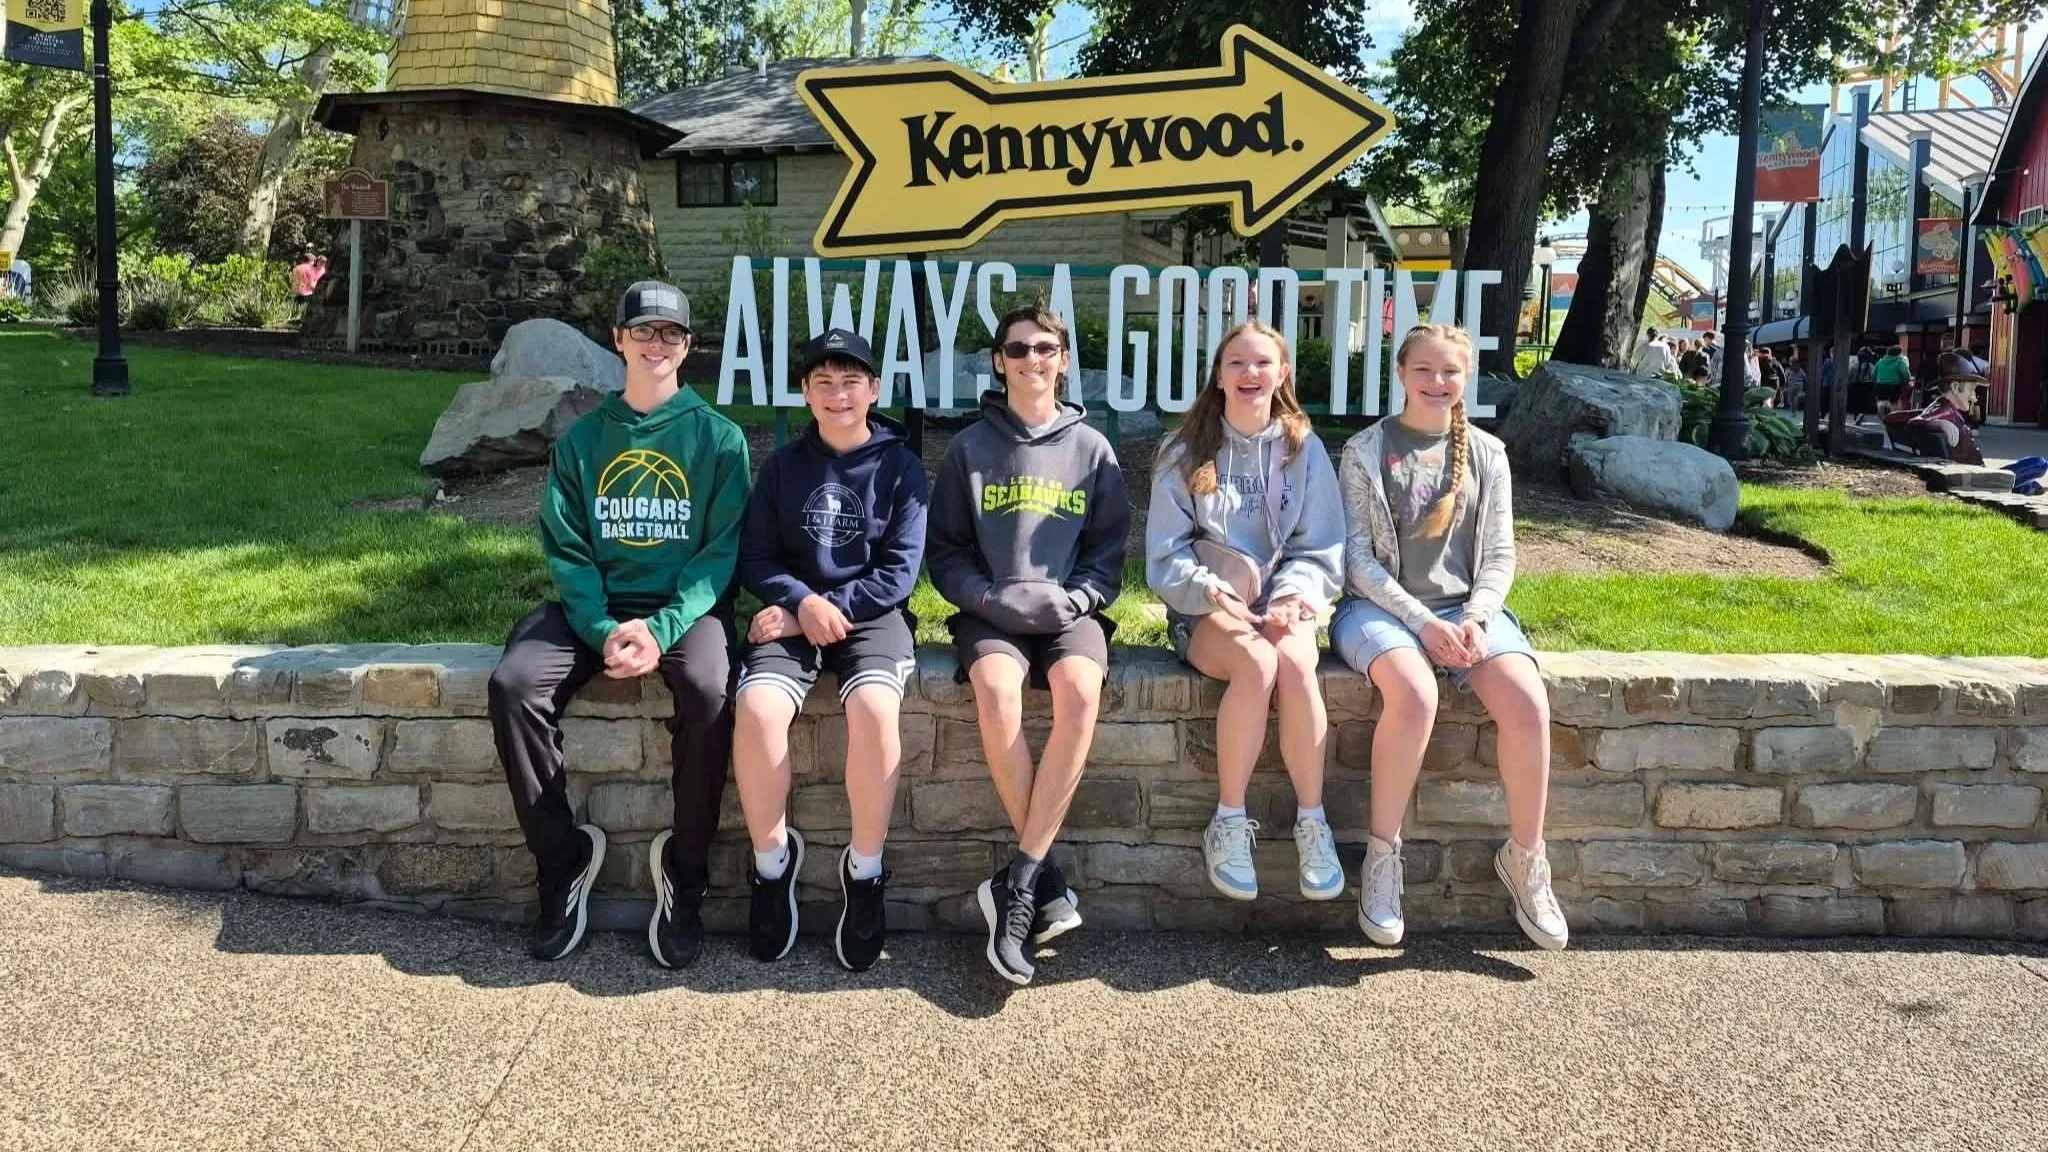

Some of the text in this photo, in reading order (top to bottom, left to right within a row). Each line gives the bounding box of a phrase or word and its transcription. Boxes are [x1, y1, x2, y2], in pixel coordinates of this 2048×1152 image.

[1325, 268, 1502, 418] TIME
[594, 496, 691, 521] COUGARS
[983, 484, 1086, 515] SEAHAWKS
[601, 521, 689, 540] BASKETBALL
